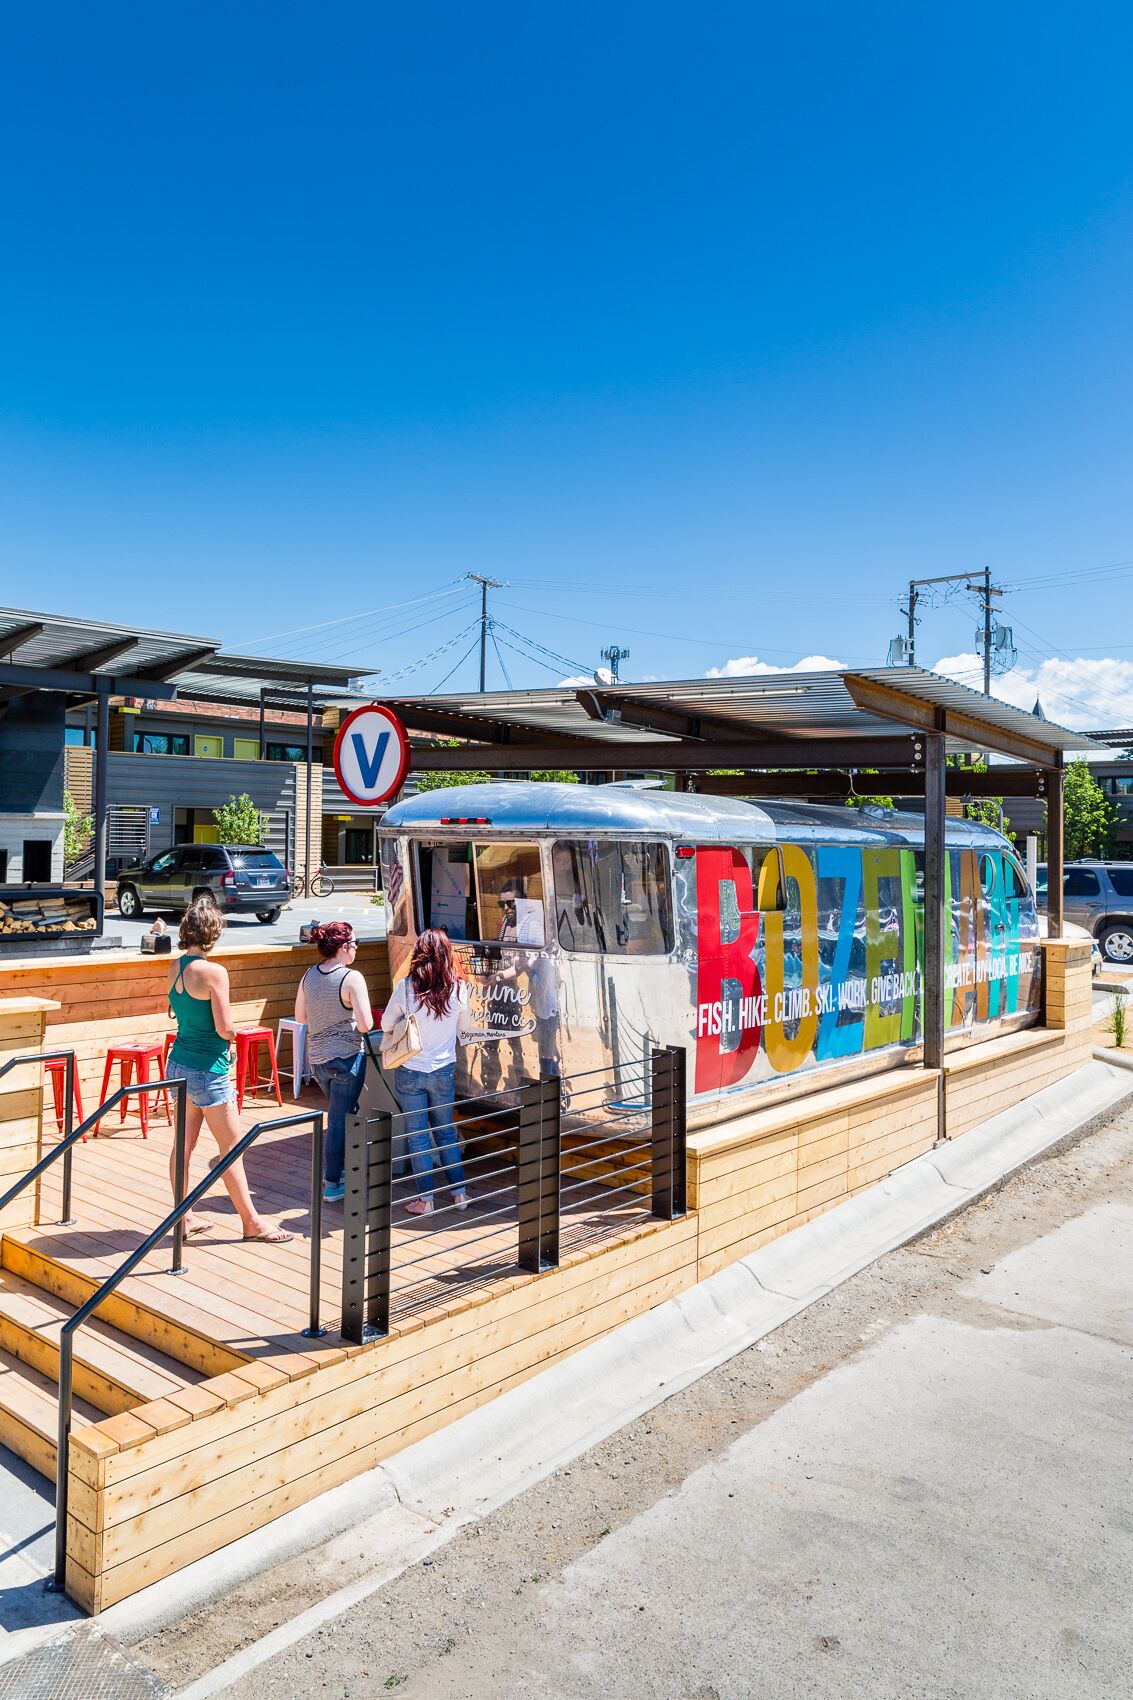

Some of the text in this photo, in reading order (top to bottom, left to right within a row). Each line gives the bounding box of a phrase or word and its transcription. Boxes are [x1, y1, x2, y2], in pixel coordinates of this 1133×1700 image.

[351, 732, 390, 788] V
[466, 979, 532, 1006] nuine
[695, 844, 1021, 1094] BOZEMAN
[698, 1001, 735, 1037] FISH.
[738, 994, 771, 1030] HIKE.
[774, 988, 812, 1023] CLIMB.
[815, 984, 836, 1015] SKI.
[838, 978, 869, 1011] WORK.
[871, 975, 893, 1004] GIVE
[893, 971, 918, 999] BACK.
[1009, 952, 1018, 977] BE
